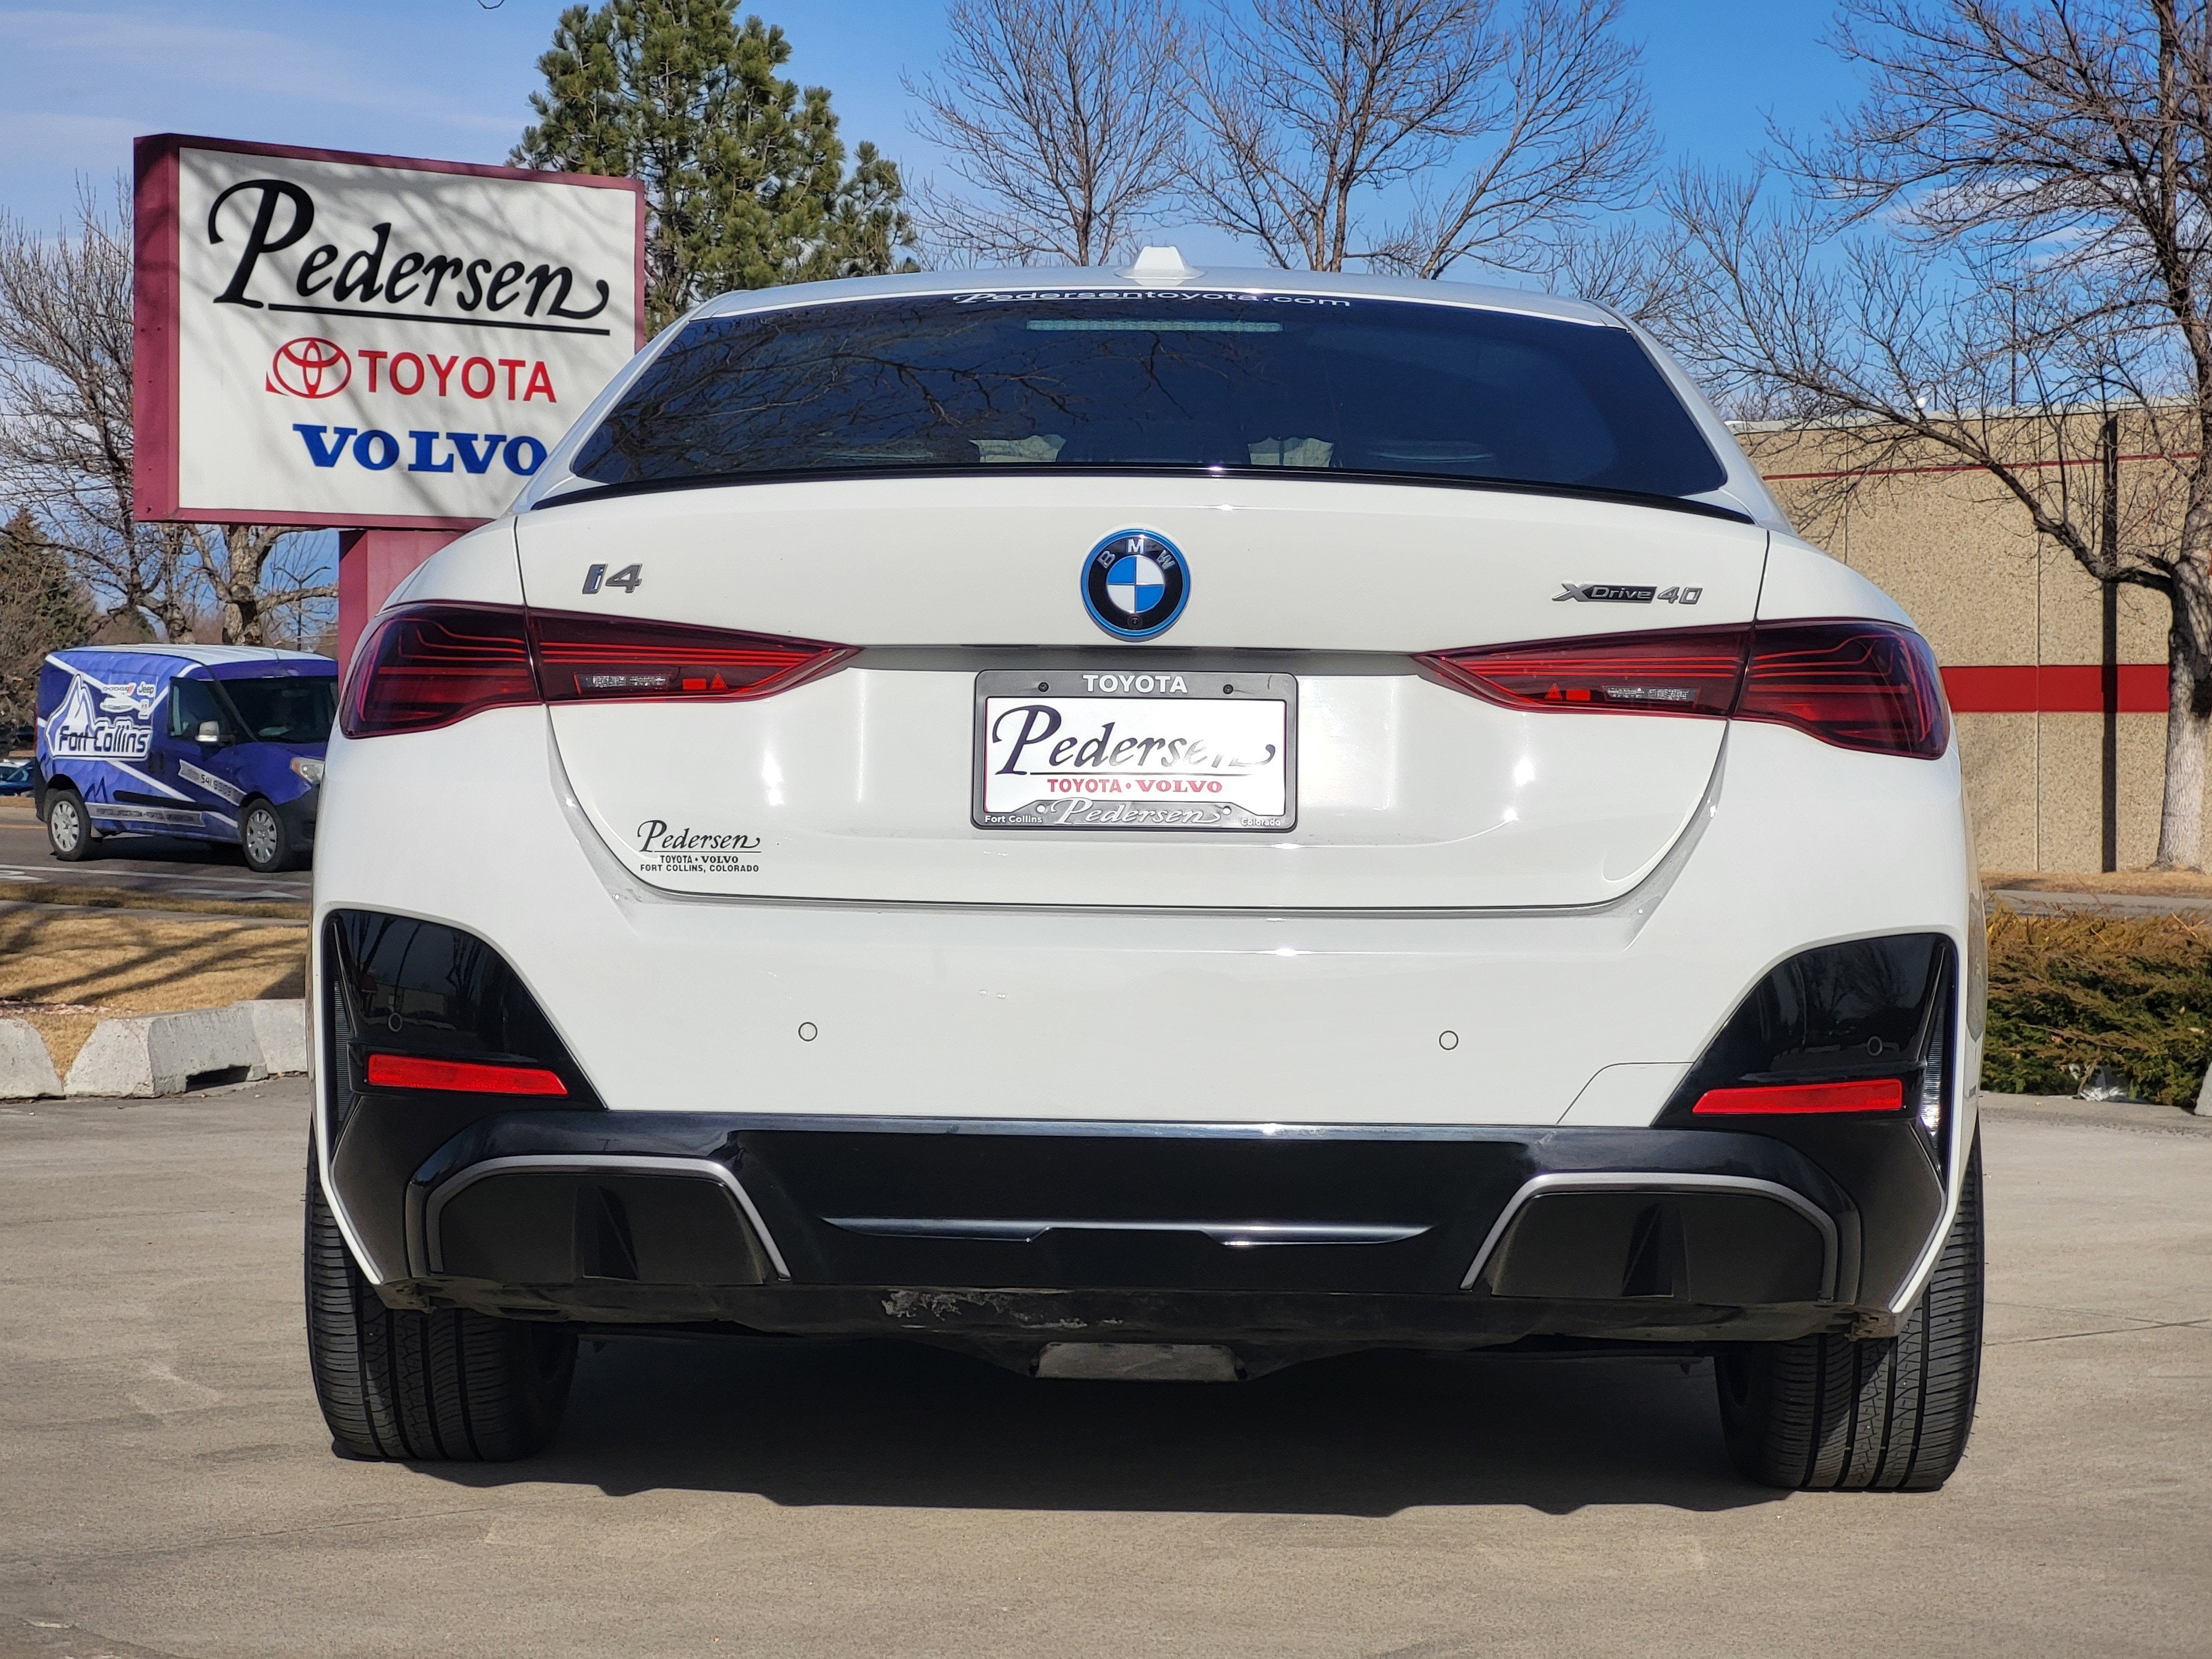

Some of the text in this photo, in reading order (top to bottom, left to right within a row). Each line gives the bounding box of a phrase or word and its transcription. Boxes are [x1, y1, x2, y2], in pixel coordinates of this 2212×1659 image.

[208, 179, 610, 320] Pedersen
[953, 291, 1350, 306] Pedersentoyota.com
[358, 349, 557, 403] TOYOTA
[293, 424, 547, 476] VOLVO
[1097, 539, 1176, 570] BMW
[582, 564, 643, 594] i4
[1083, 674, 1188, 694] TOYOTA
[59, 725, 151, 753] Fort Collins
[1047, 779, 1223, 793] TOYOTA VOLVO
[984, 815, 1043, 824] Fort Collins
[1050, 797, 1220, 825] Pedersen
[1241, 817, 1282, 826] Colorado
[637, 820, 761, 852] Pedersen
[660, 855, 739, 864] TOYOTA VOLVO
[666, 864, 706, 873] COLLINS,
